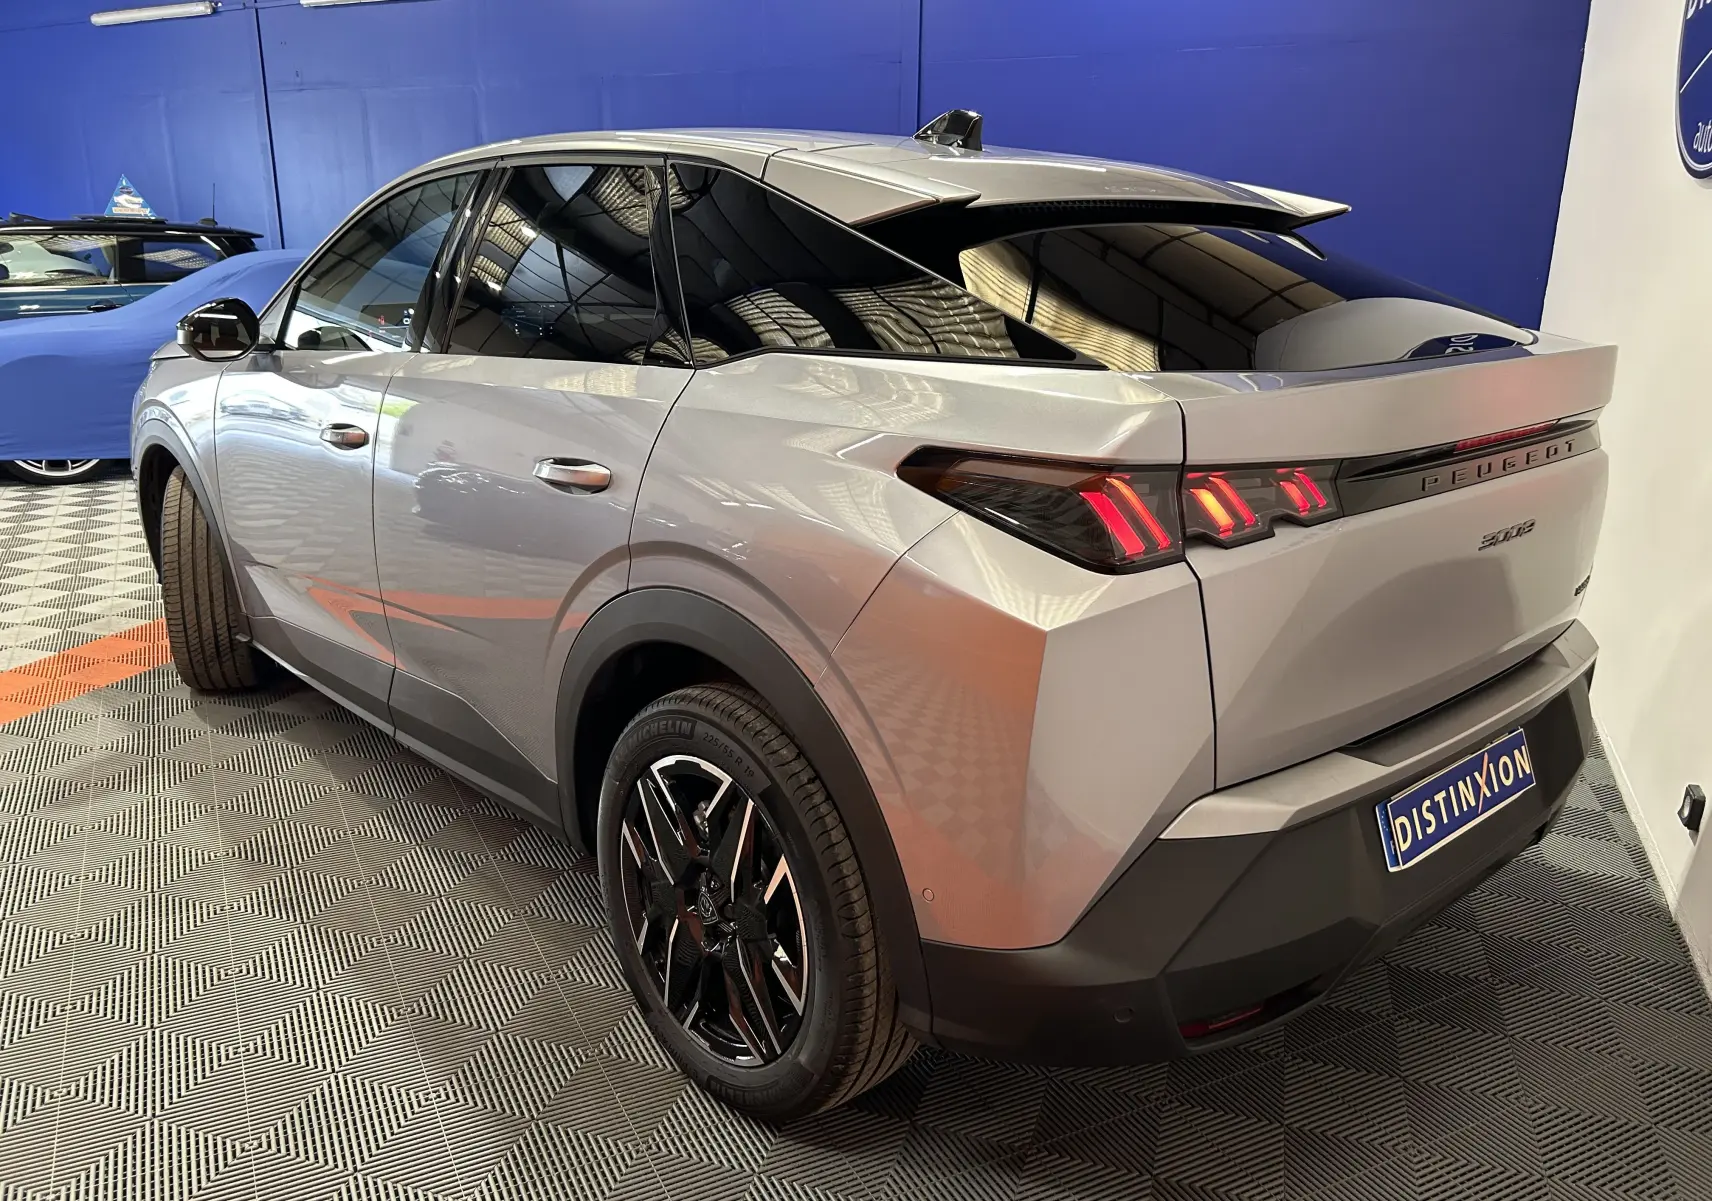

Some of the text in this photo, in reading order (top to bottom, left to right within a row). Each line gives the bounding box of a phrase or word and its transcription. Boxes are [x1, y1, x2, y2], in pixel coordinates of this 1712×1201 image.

[1421, 439, 1576, 492] PEUGEOT
[1477, 518, 1536, 552] 3008
[629, 719, 693, 747] MICHELIN
[703, 732, 735, 758] 225/55
[734, 755, 743, 767] R
[744, 765, 755, 777] 19
[1394, 745, 1531, 853] DISTINXION
